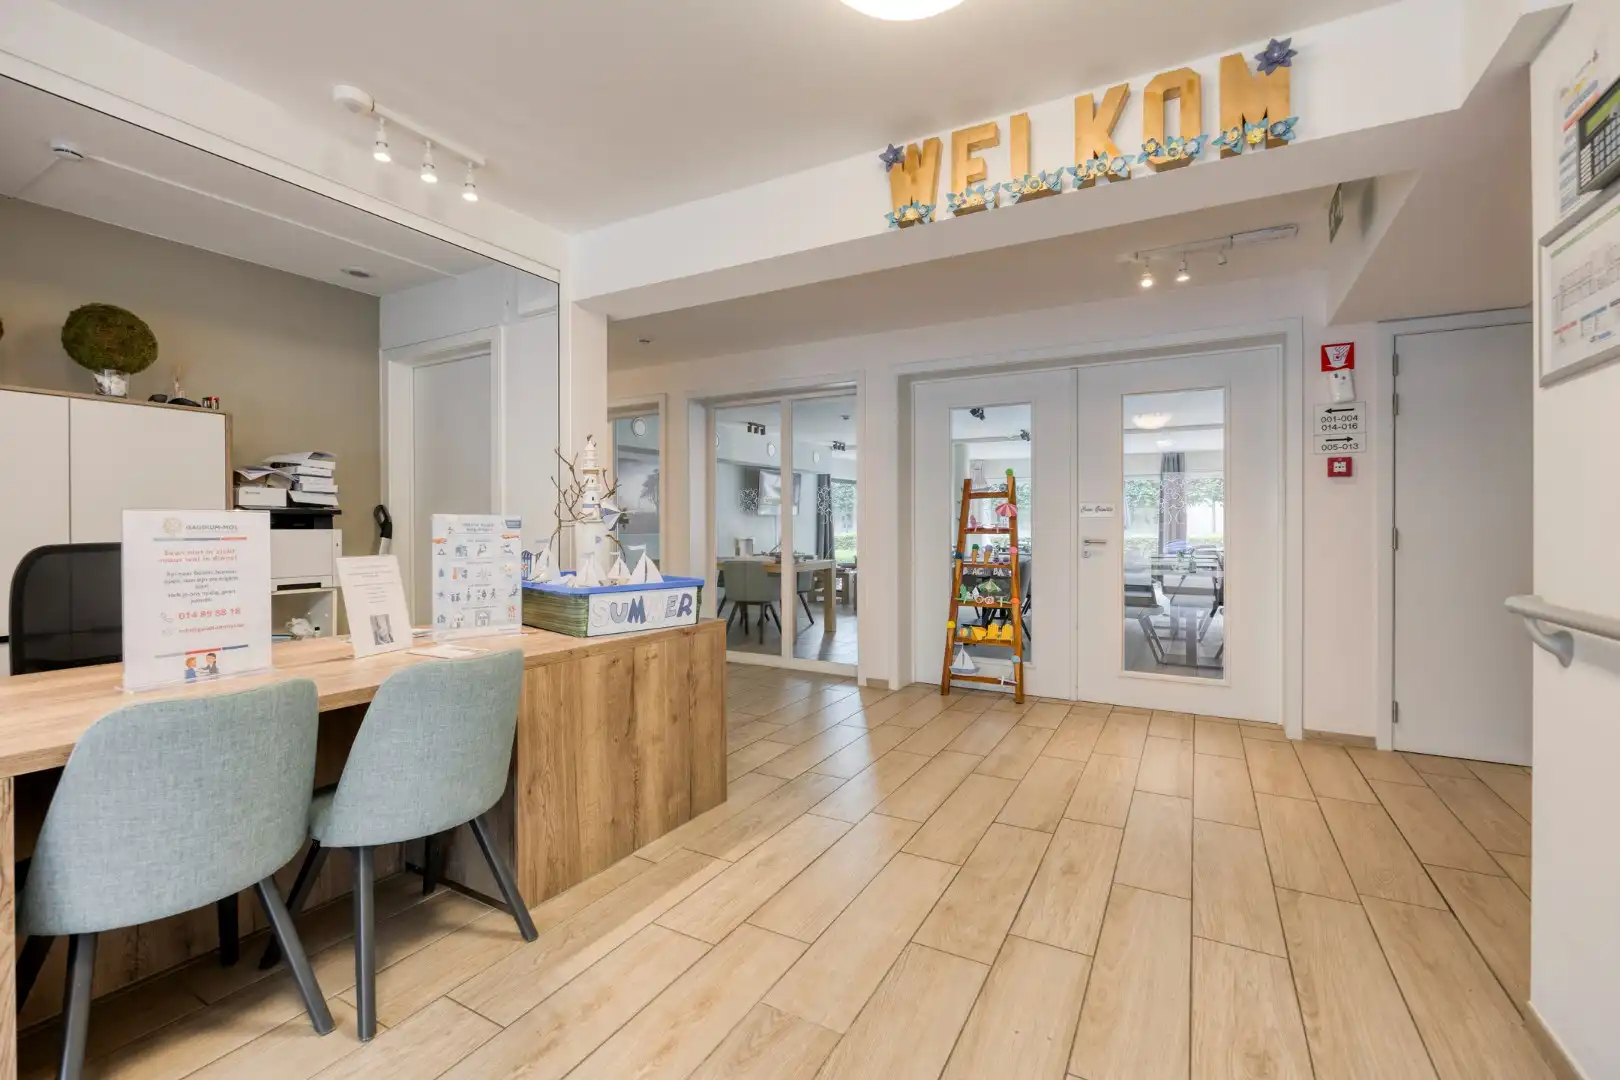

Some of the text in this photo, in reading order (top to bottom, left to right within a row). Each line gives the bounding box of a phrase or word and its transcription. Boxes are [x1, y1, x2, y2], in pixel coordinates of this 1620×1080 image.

[885, 52, 1293, 229] WELKOM
[1320, 414, 1358, 424] 001-004
[1321, 422, 1358, 432] 014-016
[1321, 442, 1359, 452] 005-013
[591, 593, 692, 628] SUMMER
